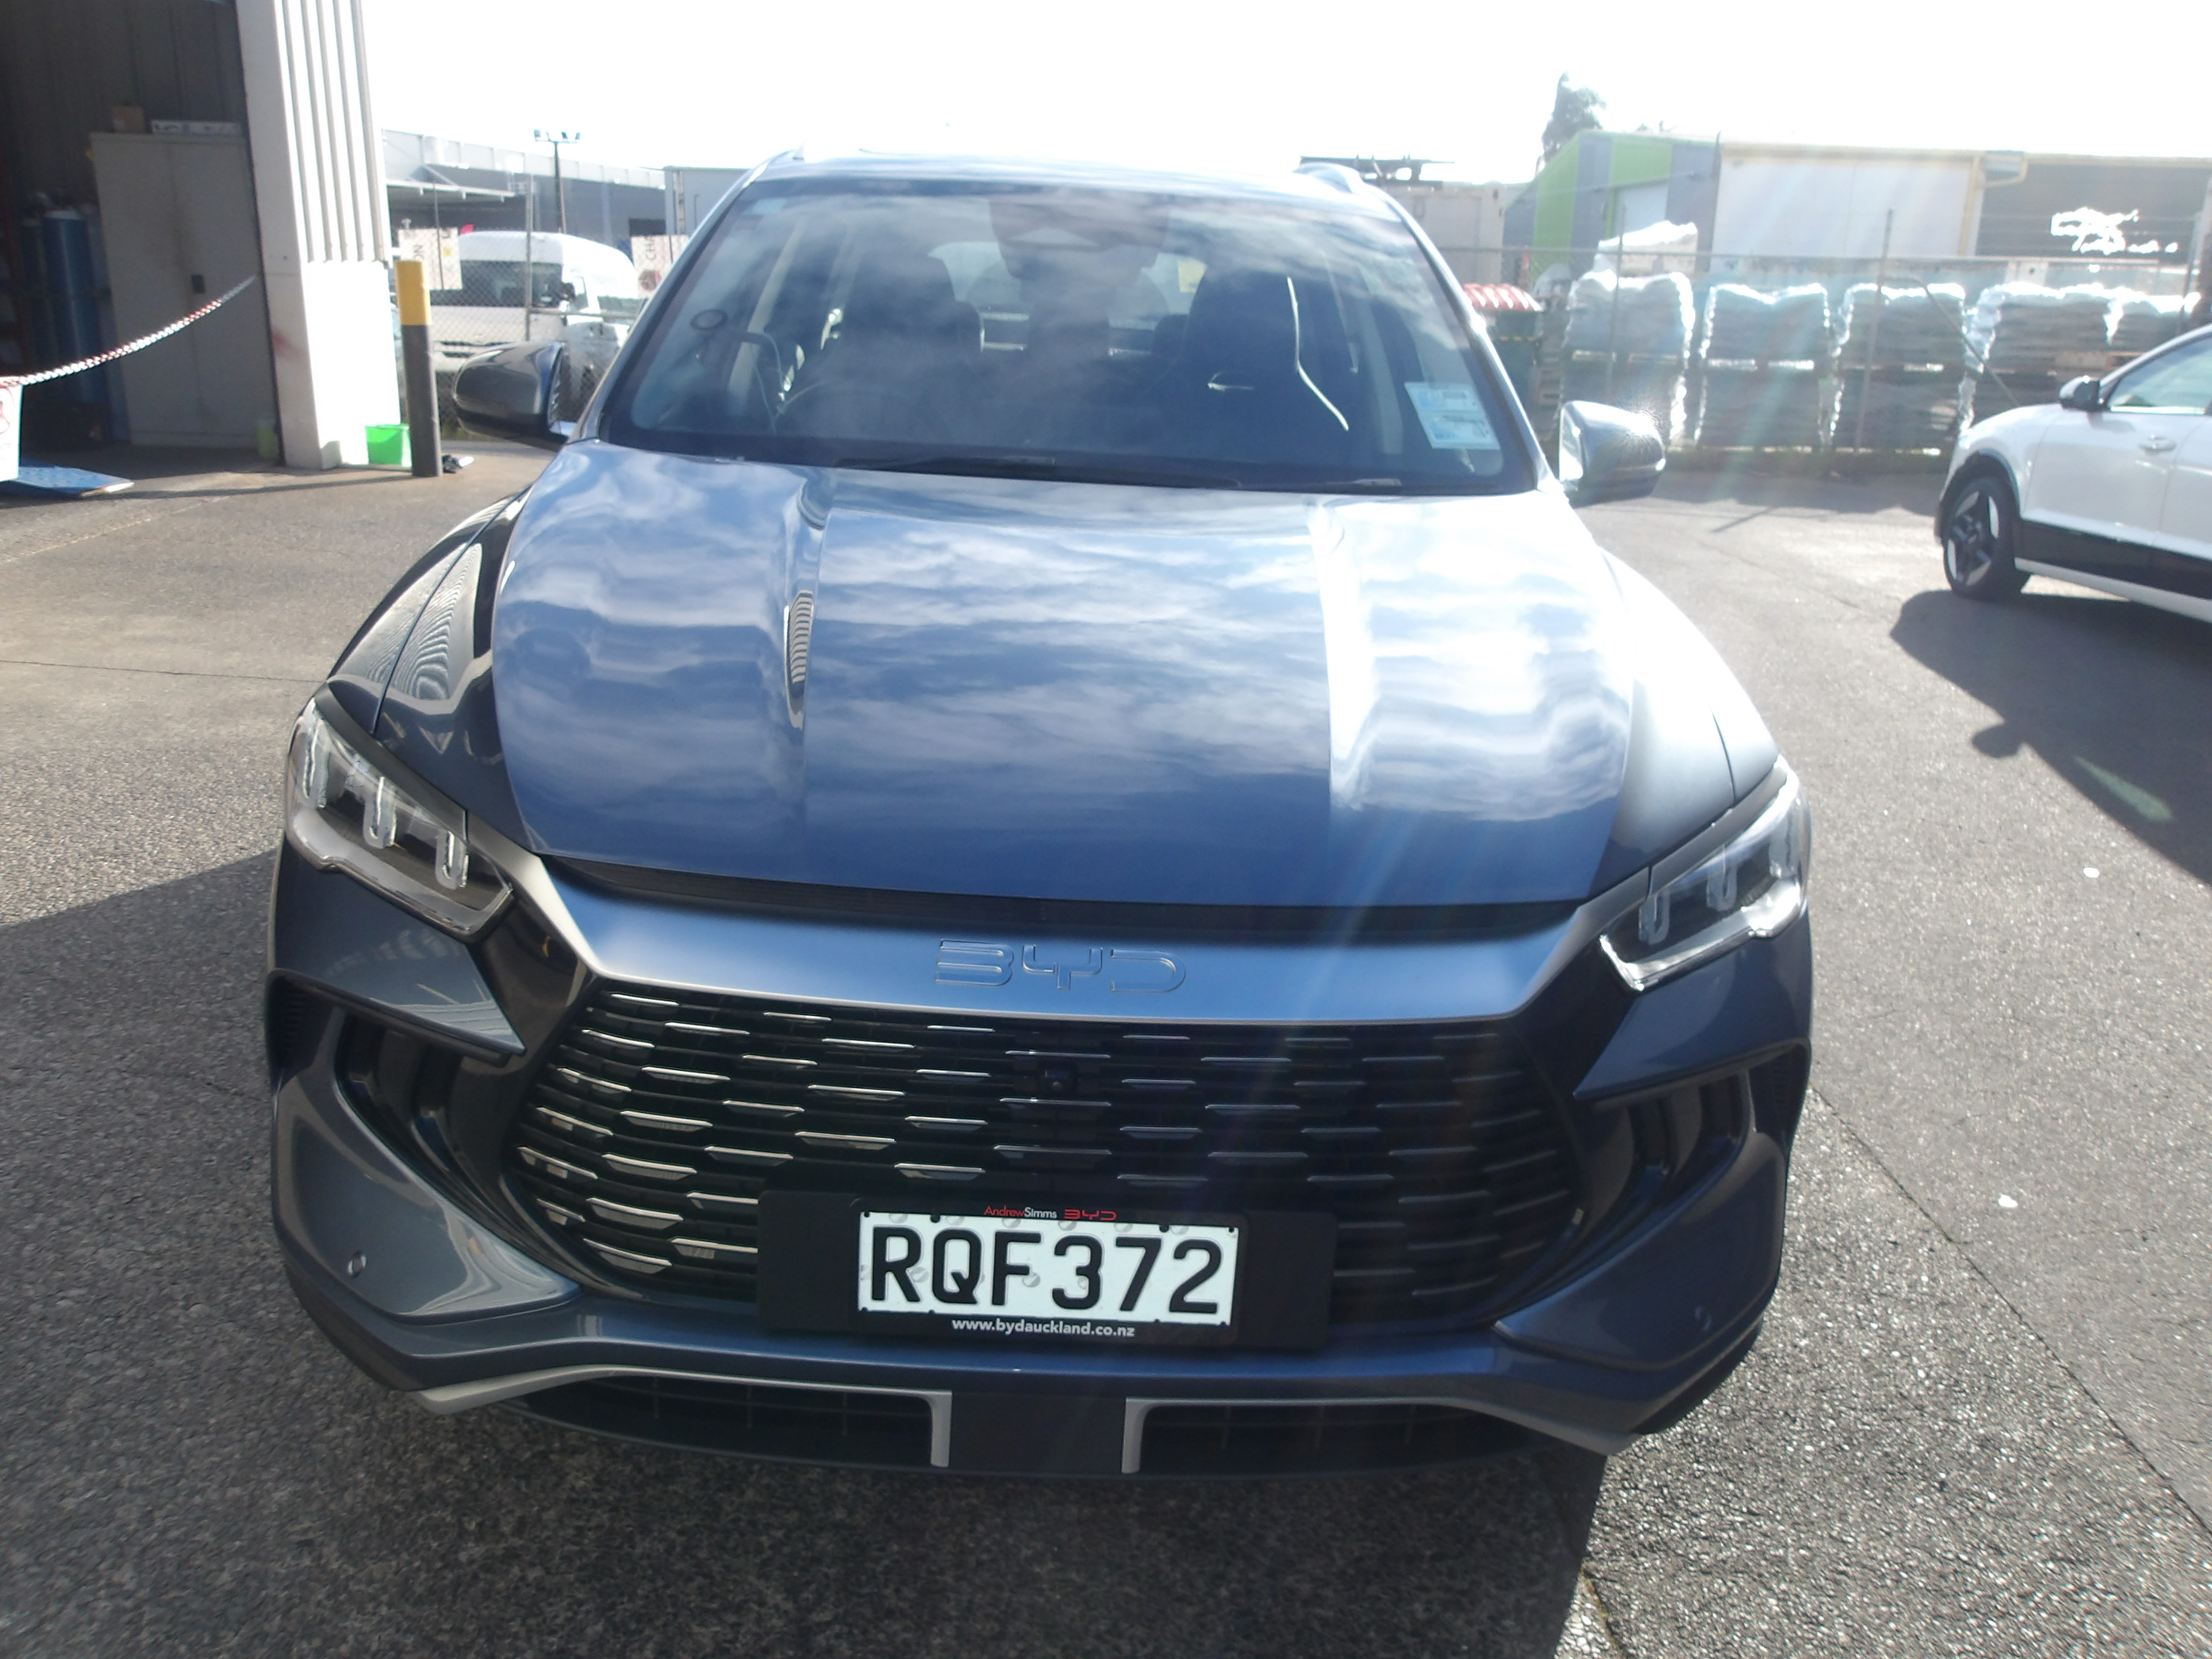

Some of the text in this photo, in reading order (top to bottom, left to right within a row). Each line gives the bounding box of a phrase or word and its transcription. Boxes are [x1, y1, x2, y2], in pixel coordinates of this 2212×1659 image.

[935, 939, 1186, 992] BYD
[1064, 1209, 1117, 1221] BYD
[871, 1226, 1223, 1314] RQF372
[951, 1318, 1135, 1337] www.bydauckland.co.nz
